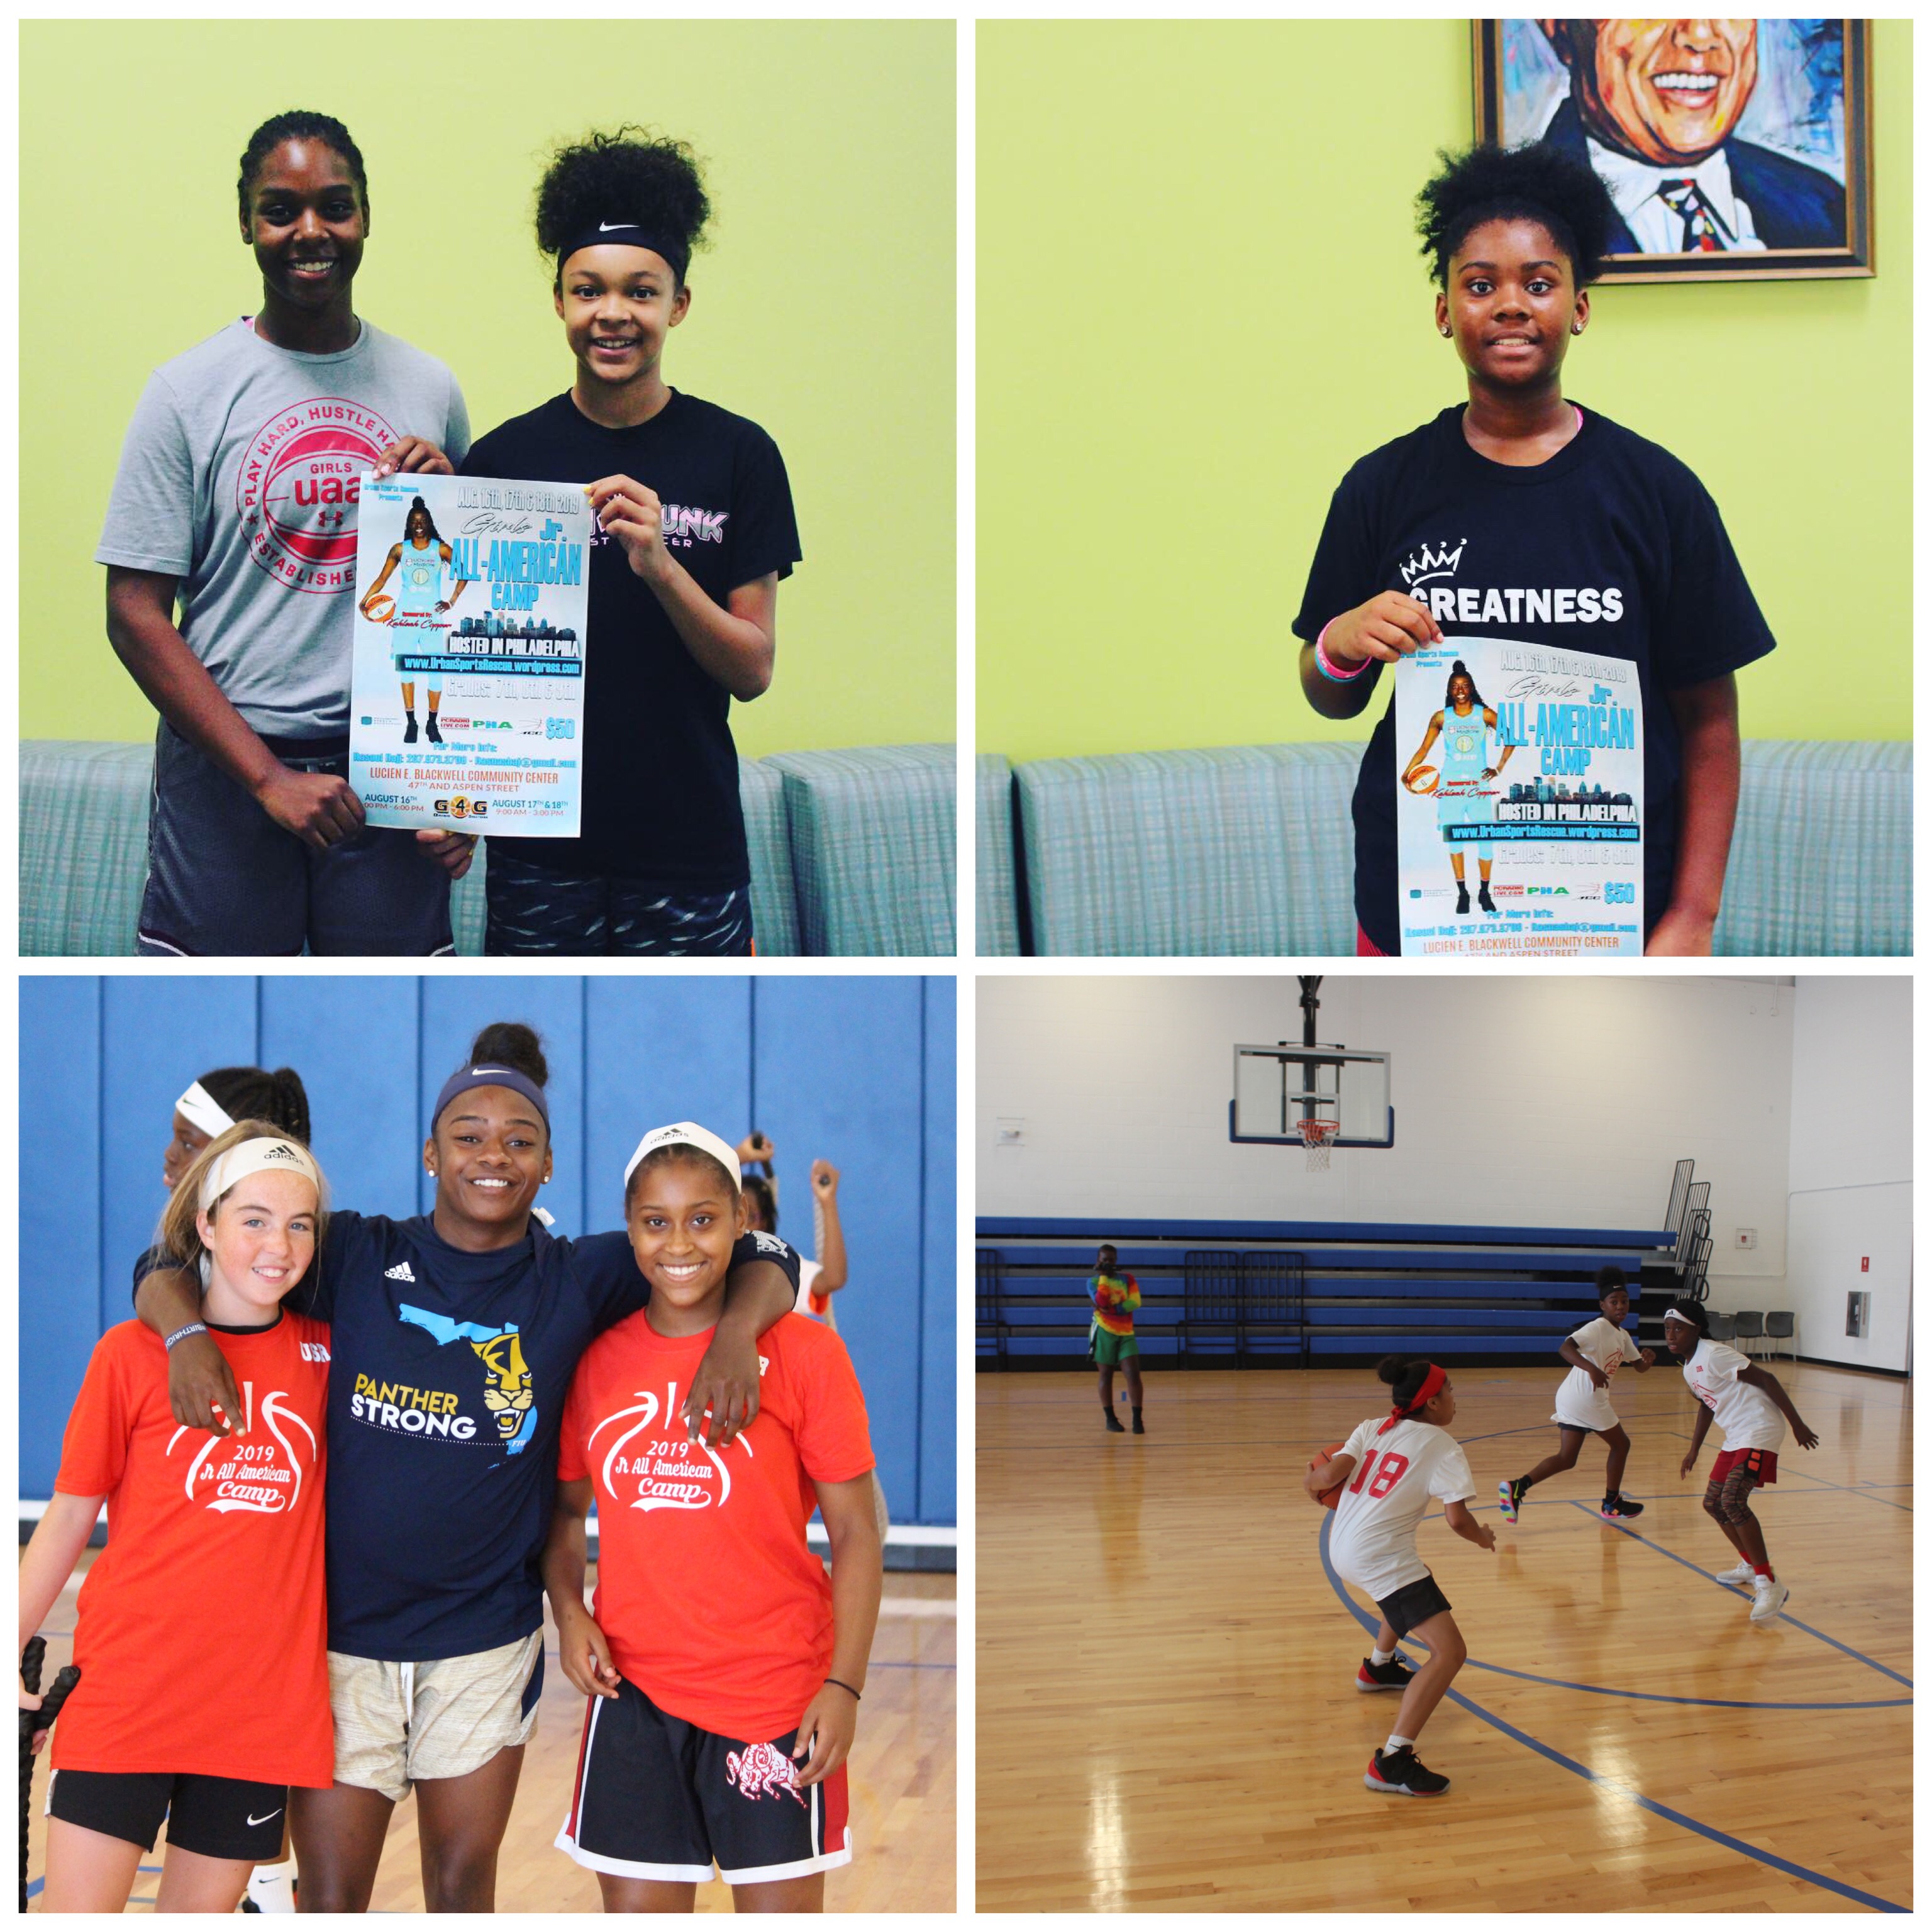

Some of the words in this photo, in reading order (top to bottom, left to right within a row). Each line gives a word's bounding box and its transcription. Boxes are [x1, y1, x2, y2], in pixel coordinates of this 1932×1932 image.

[245, 460, 262, 507] PLAY
[257, 415, 304, 455] HARD,
[308, 406, 376, 431] HUSTLE
[311, 463, 352, 474] GIRLS
[557, 494, 580, 514] 2019
[540, 519, 567, 541] Jr.
[254, 533, 355, 585] ESTABLISHE
[449, 538, 582, 586] ALL-AMERICAN
[491, 584, 539, 611] CAMP
[1409, 587, 1624, 623] GREATNESS
[449, 636, 489, 654] HOSTED
[492, 638, 503, 655] IN
[506, 638, 580, 657] PHILADELPHIA
[404, 657, 579, 675] www.UrbanSportsRescue.wordpress.com
[1589, 684, 1617, 706] Jr.
[546, 717, 575, 740] $50
[1495, 702, 1635, 749] ALL-AMERICAN
[1541, 748, 1591, 776] CAMP
[370, 767, 401, 779] LUCIEN
[404, 769, 411, 779] E.
[415, 769, 465, 781] BLACKWELL
[468, 770, 523, 783] COMMUNITY
[526, 772, 558, 784] CENTER
[365, 794, 399, 803] AUGUST
[486, 784, 519, 792] STREET
[492, 799, 526, 808] AUGUST
[1498, 803, 1541, 821] HOSTED
[1543, 804, 1556, 821] IN
[1558, 804, 1636, 821] PHILADELPHIA
[1604, 882, 1635, 904] $50
[1424, 940, 1456, 953] LUCIEN
[1469, 937, 1522, 951] BLACKWELL
[1524, 936, 1582, 948] COMMUNITY
[1584, 936, 1619, 948] CENTER
[650, 1131, 689, 1144] adidas
[264, 1152, 304, 1165] adidas
[384, 1270, 416, 1282] adidas
[165, 1324, 206, 1348] #BIRTHRIGH
[299, 1341, 331, 1362] USR
[354, 1374, 458, 1415] PANTHER
[351, 1393, 477, 1440] STRONG
[233, 1445, 274, 1462] 2019
[511, 1439, 527, 1447] FIU
[646, 1440, 689, 1458] 2019
[216, 1463, 235, 1480] All
[236, 1463, 291, 1483] American
[631, 1457, 650, 1475] All
[652, 1458, 713, 1479] American
[1349, 1449, 1410, 1499] 18
[217, 1480, 279, 1506] Camp
[638, 1477, 701, 1503] Camp
